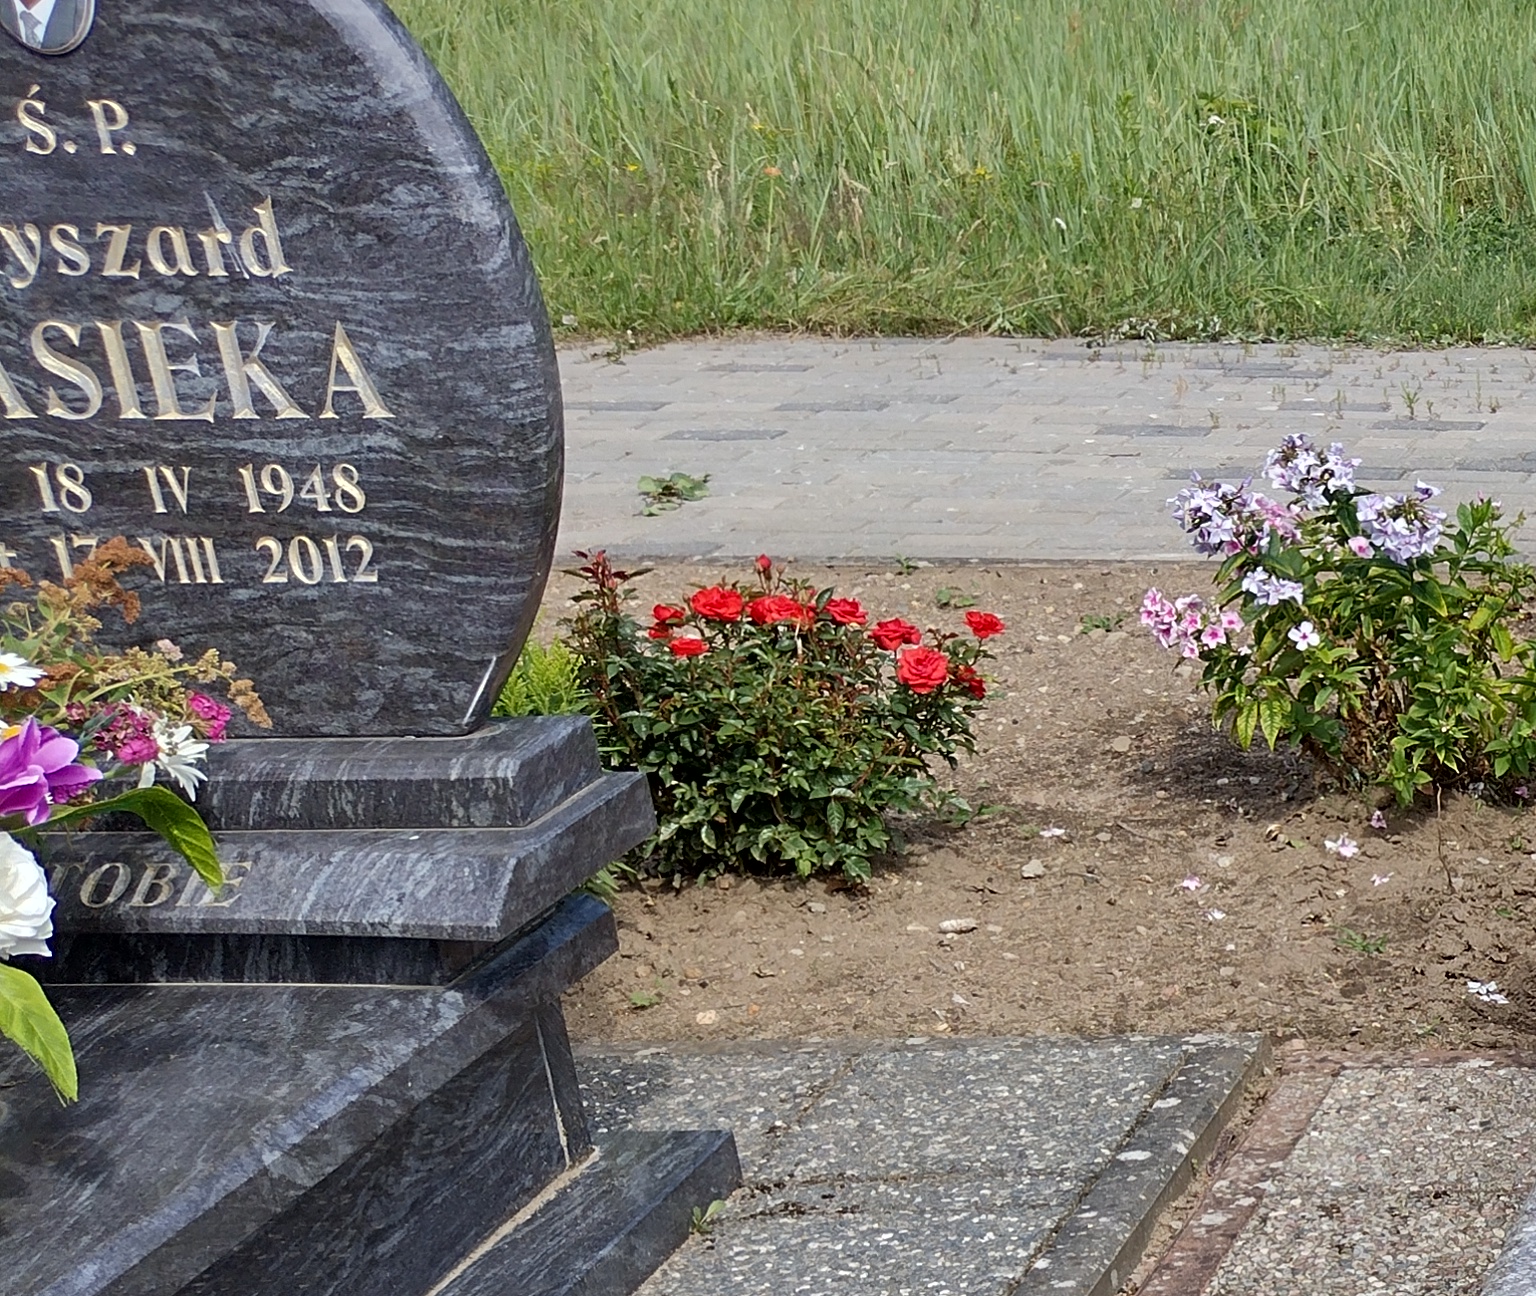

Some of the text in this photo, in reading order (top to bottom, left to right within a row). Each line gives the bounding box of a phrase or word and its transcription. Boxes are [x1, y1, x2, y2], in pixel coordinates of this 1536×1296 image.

[17, 83, 137, 156] Ś. P.
[0, 195, 293, 289] yszard
[29, 462, 366, 514] 18 IV 1948
[137, 536, 224, 584] VIII
[256, 534, 379, 585] 2012
